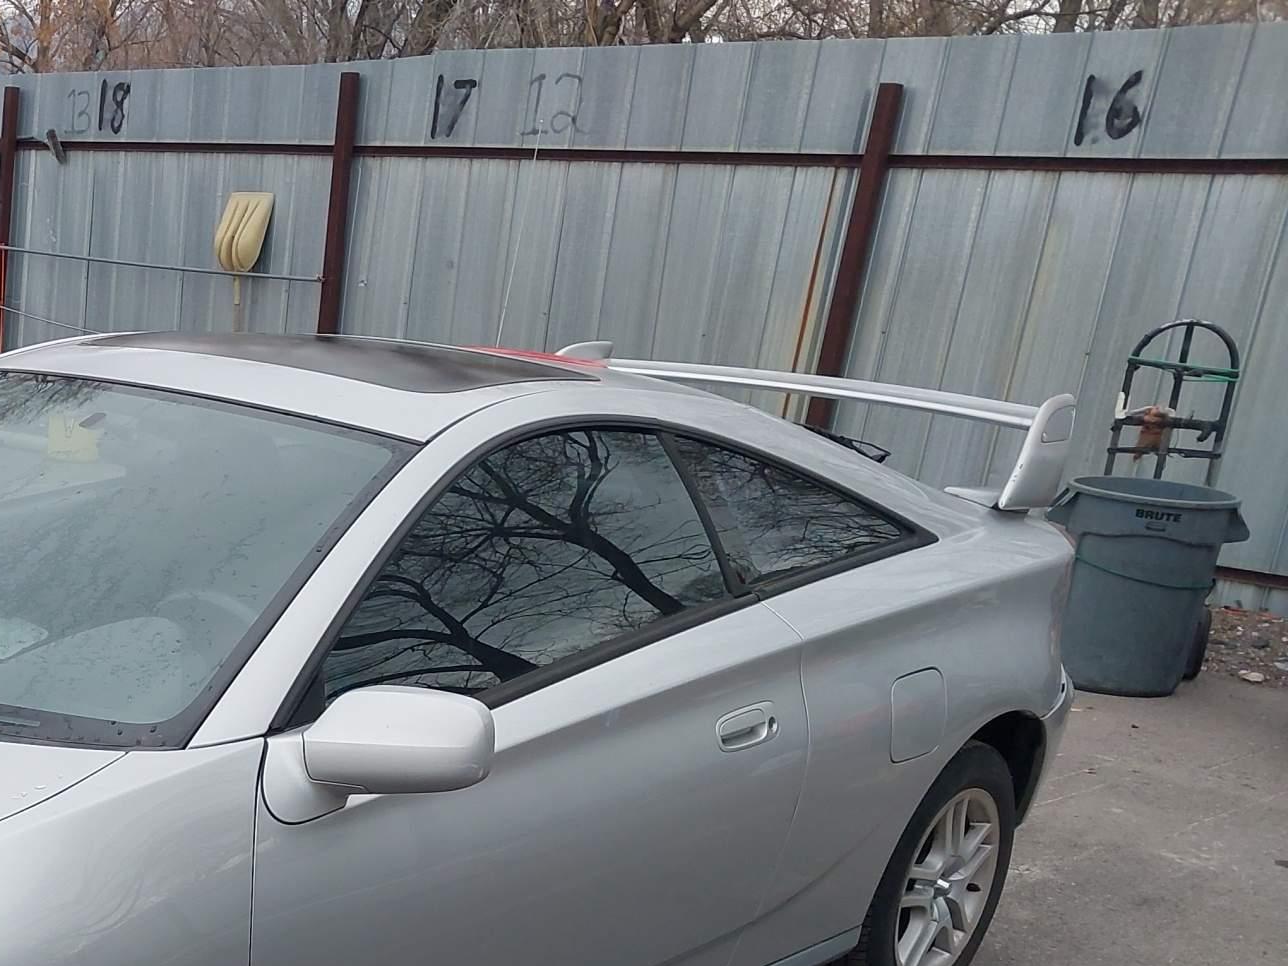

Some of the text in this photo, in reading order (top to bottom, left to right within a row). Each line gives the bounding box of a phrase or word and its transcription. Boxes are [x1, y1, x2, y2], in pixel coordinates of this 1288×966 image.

[64, 89, 91, 134] 13
[98, 78, 130, 135] 18
[430, 74, 477, 139] 17
[520, 73, 589, 135] 12
[1074, 70, 1143, 146] 16
[1135, 508, 1182, 523] BRUTE
